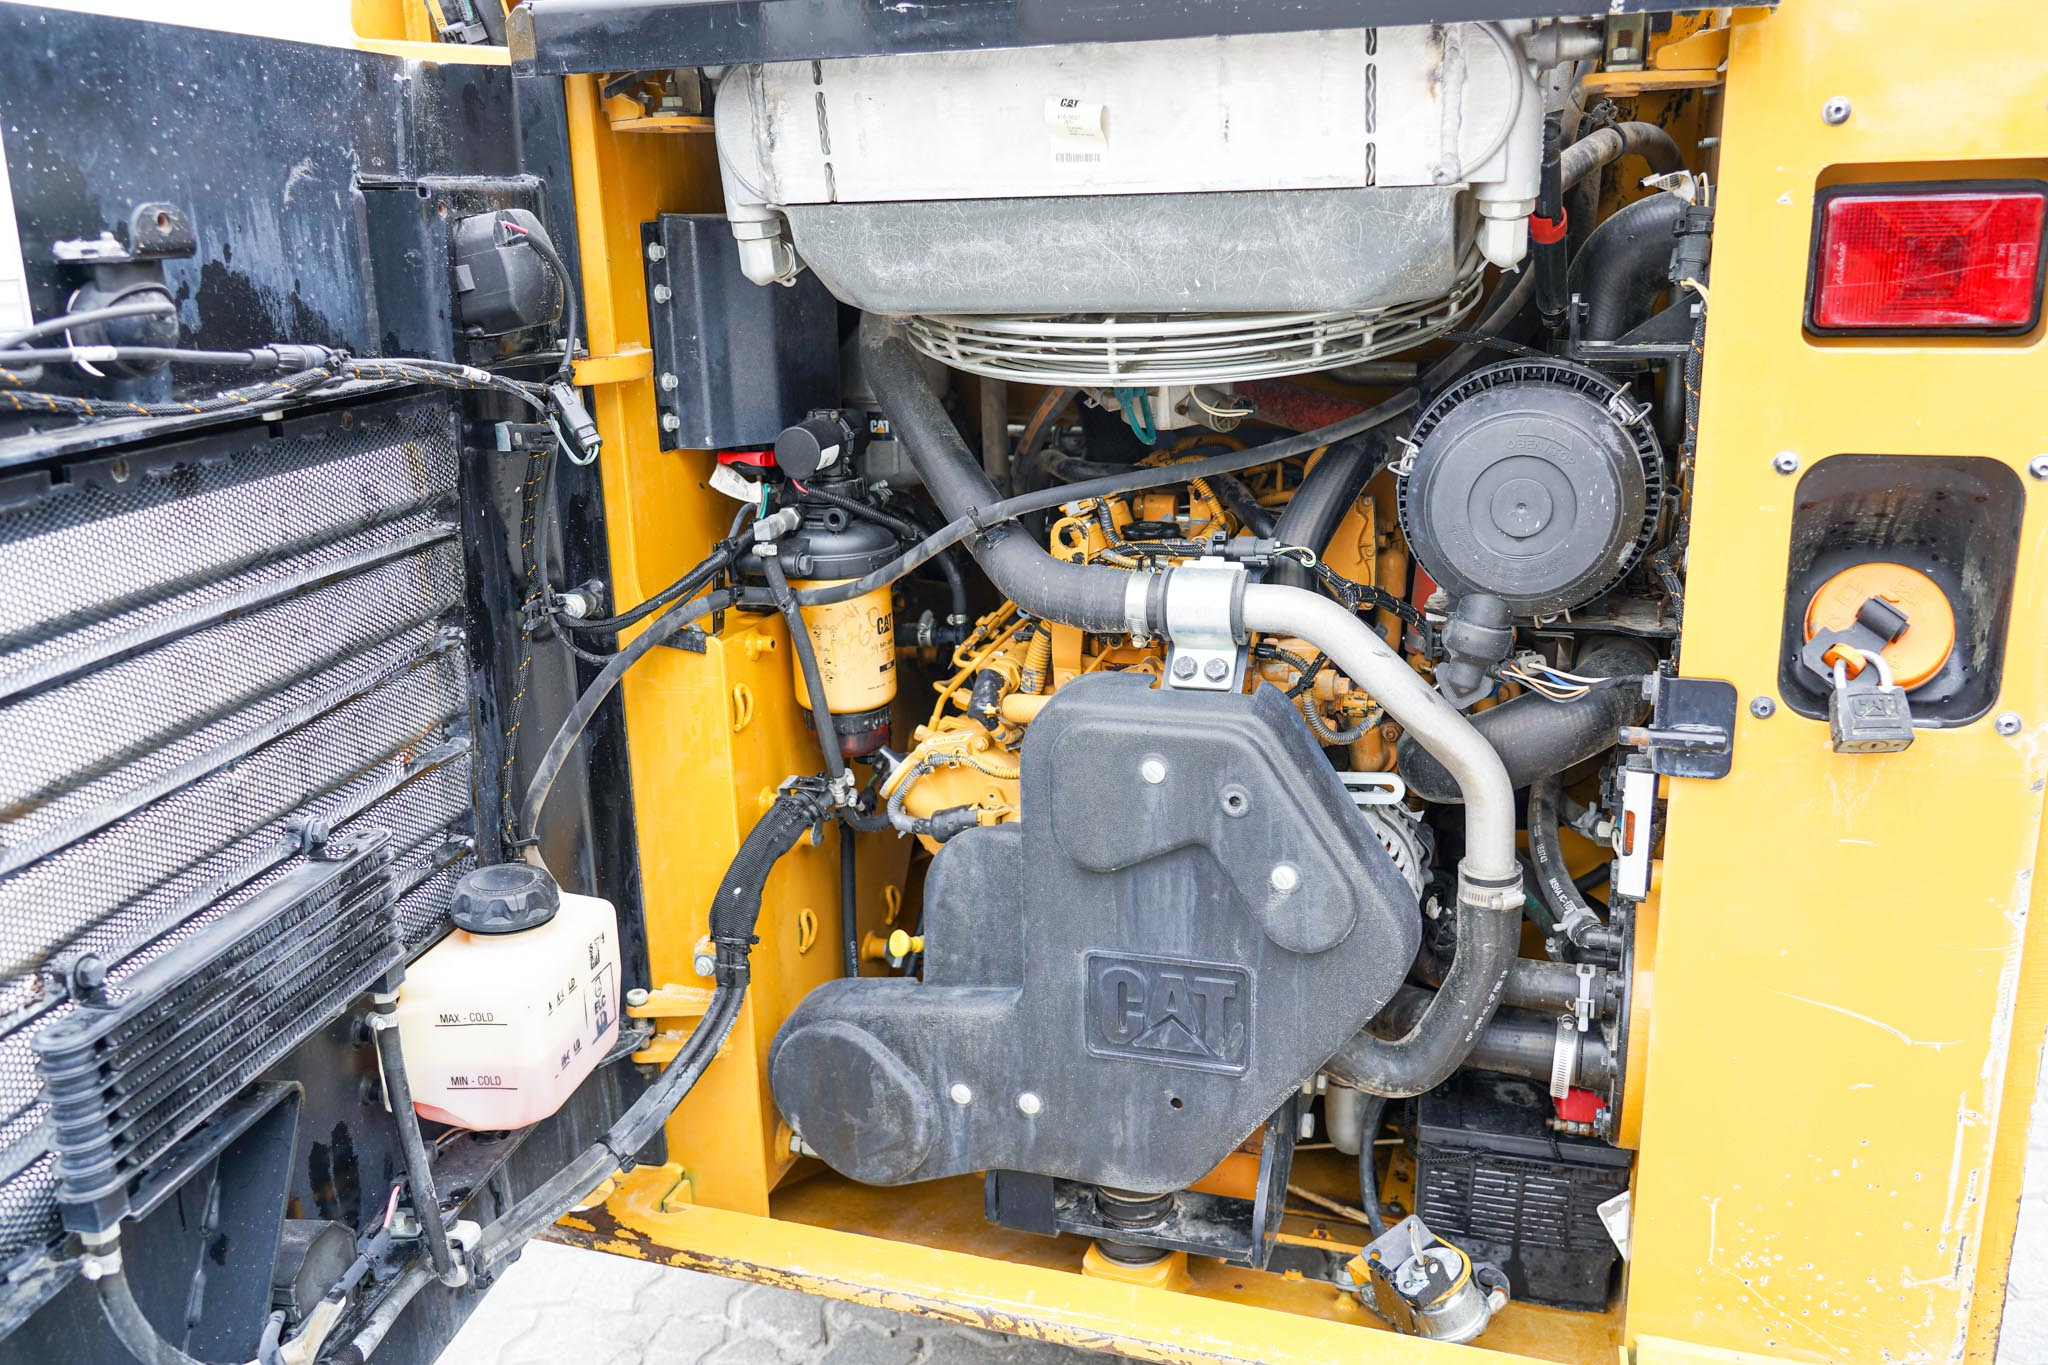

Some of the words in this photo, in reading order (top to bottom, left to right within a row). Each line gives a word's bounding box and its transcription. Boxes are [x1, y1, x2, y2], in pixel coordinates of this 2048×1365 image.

[870, 420, 890, 433] CAT
[1549, 877, 1564, 898] MSHA
[594, 993, 607, 1016] ELC
[1101, 966, 1238, 1058] CAT
[439, 1013, 461, 1024] MAX
[469, 1012, 494, 1023] COLD
[450, 1076, 469, 1086] MIN
[477, 1075, 502, 1086] COLD
